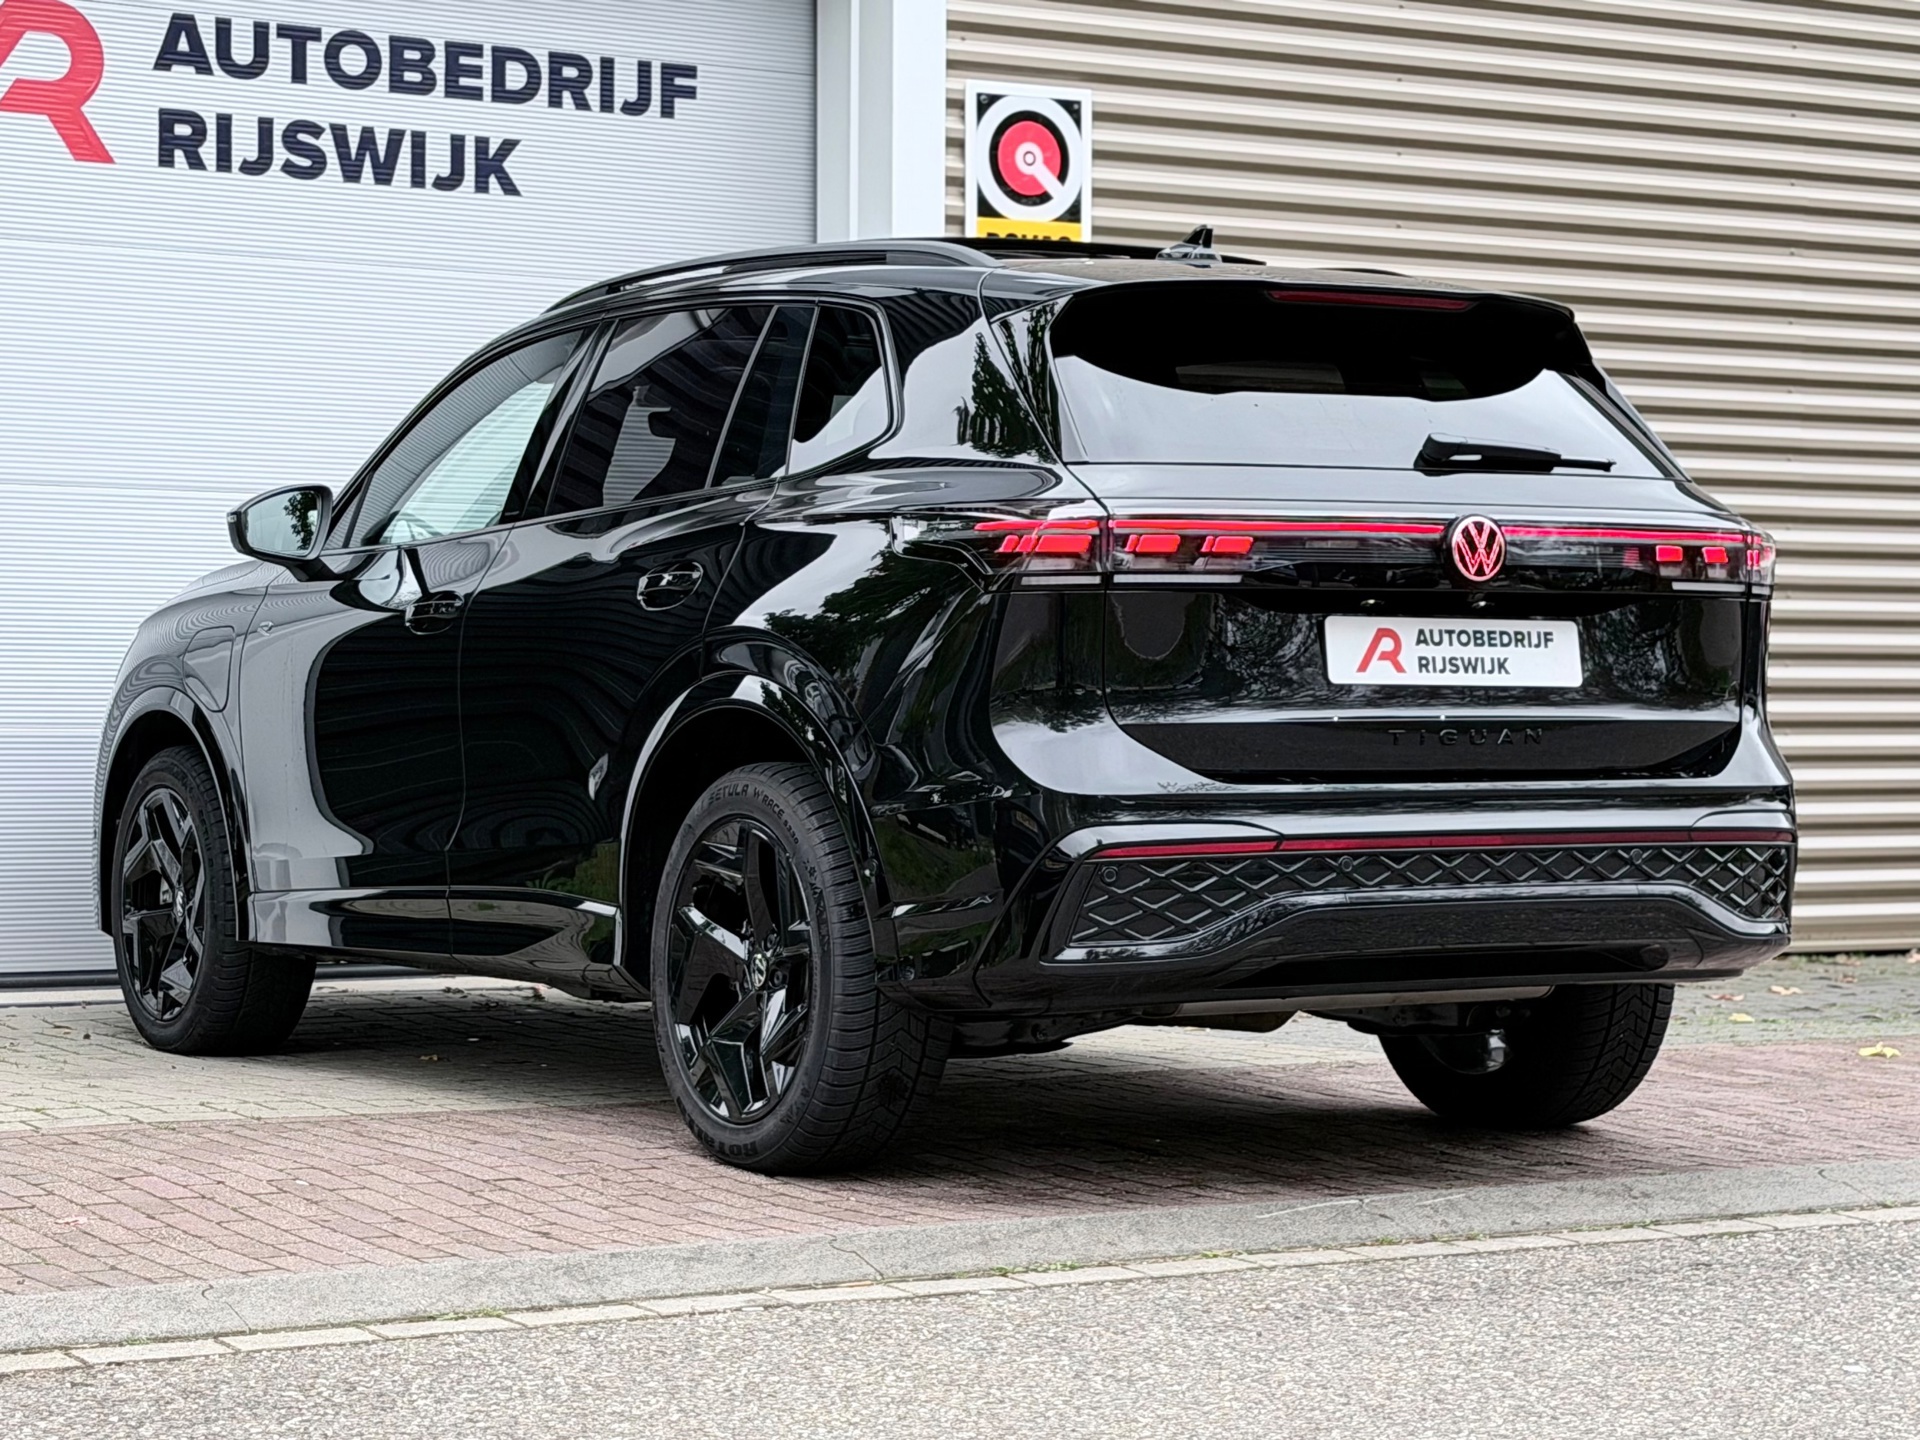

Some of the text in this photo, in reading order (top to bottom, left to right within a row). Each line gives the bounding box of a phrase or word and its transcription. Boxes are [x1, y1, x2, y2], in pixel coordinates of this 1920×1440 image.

[153, 12, 698, 119] AUTOBEDRIJF
[157, 107, 523, 197] RIJSWIJK
[1415, 628, 1555, 649] AUTOBEDRIJF
[1417, 656, 1511, 675] RIJSWIJK
[1388, 728, 1543, 746] TIGUAN
[761, 794, 785, 820] RACE
